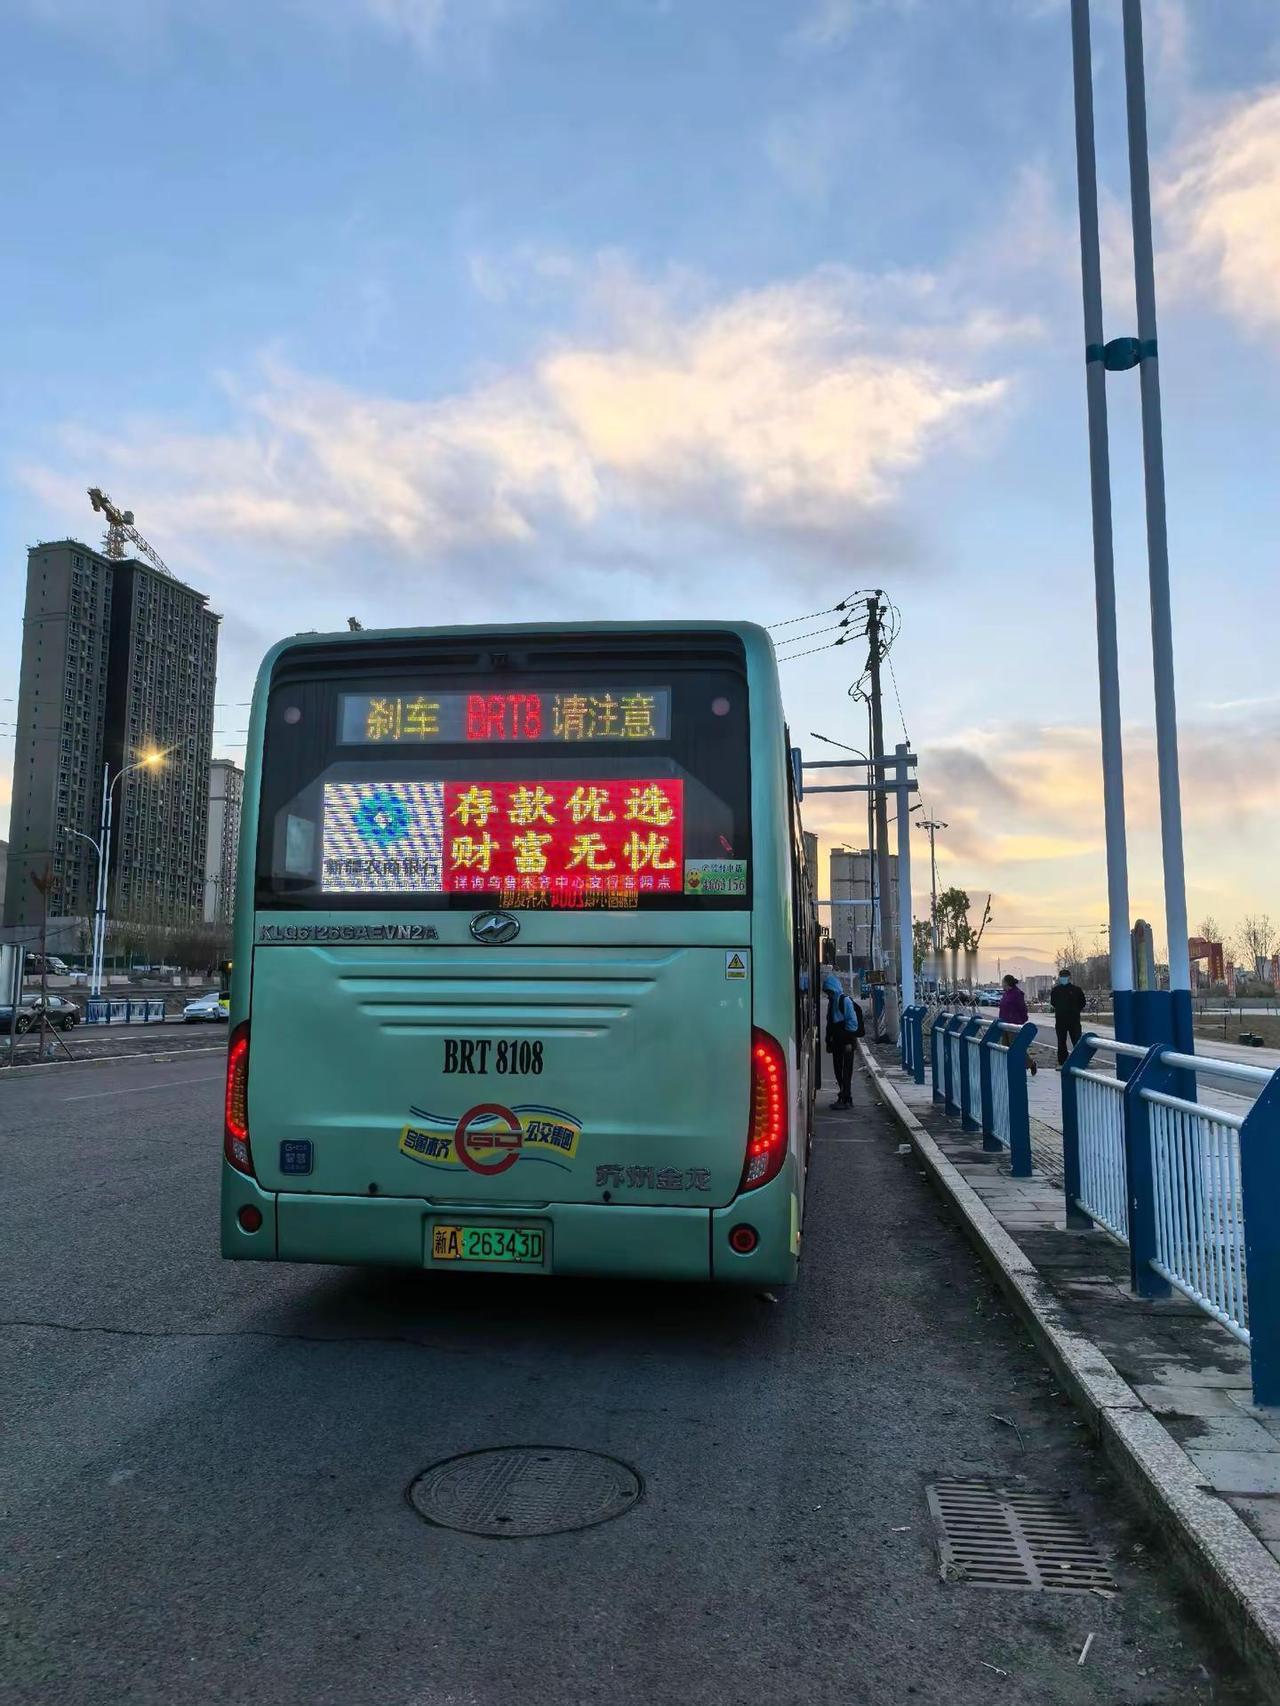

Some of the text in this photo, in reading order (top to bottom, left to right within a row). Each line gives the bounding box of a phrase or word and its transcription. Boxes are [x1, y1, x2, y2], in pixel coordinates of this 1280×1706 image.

[366, 692, 656, 740] 刹车 BRT8 请注意
[450, 784, 676, 826] 存款优选
[450, 831, 677, 873] 财富无忧
[442, 1040, 544, 1075] BRT 8108
[403, 1120, 576, 1159] 乌鲁木齐 公交集团
